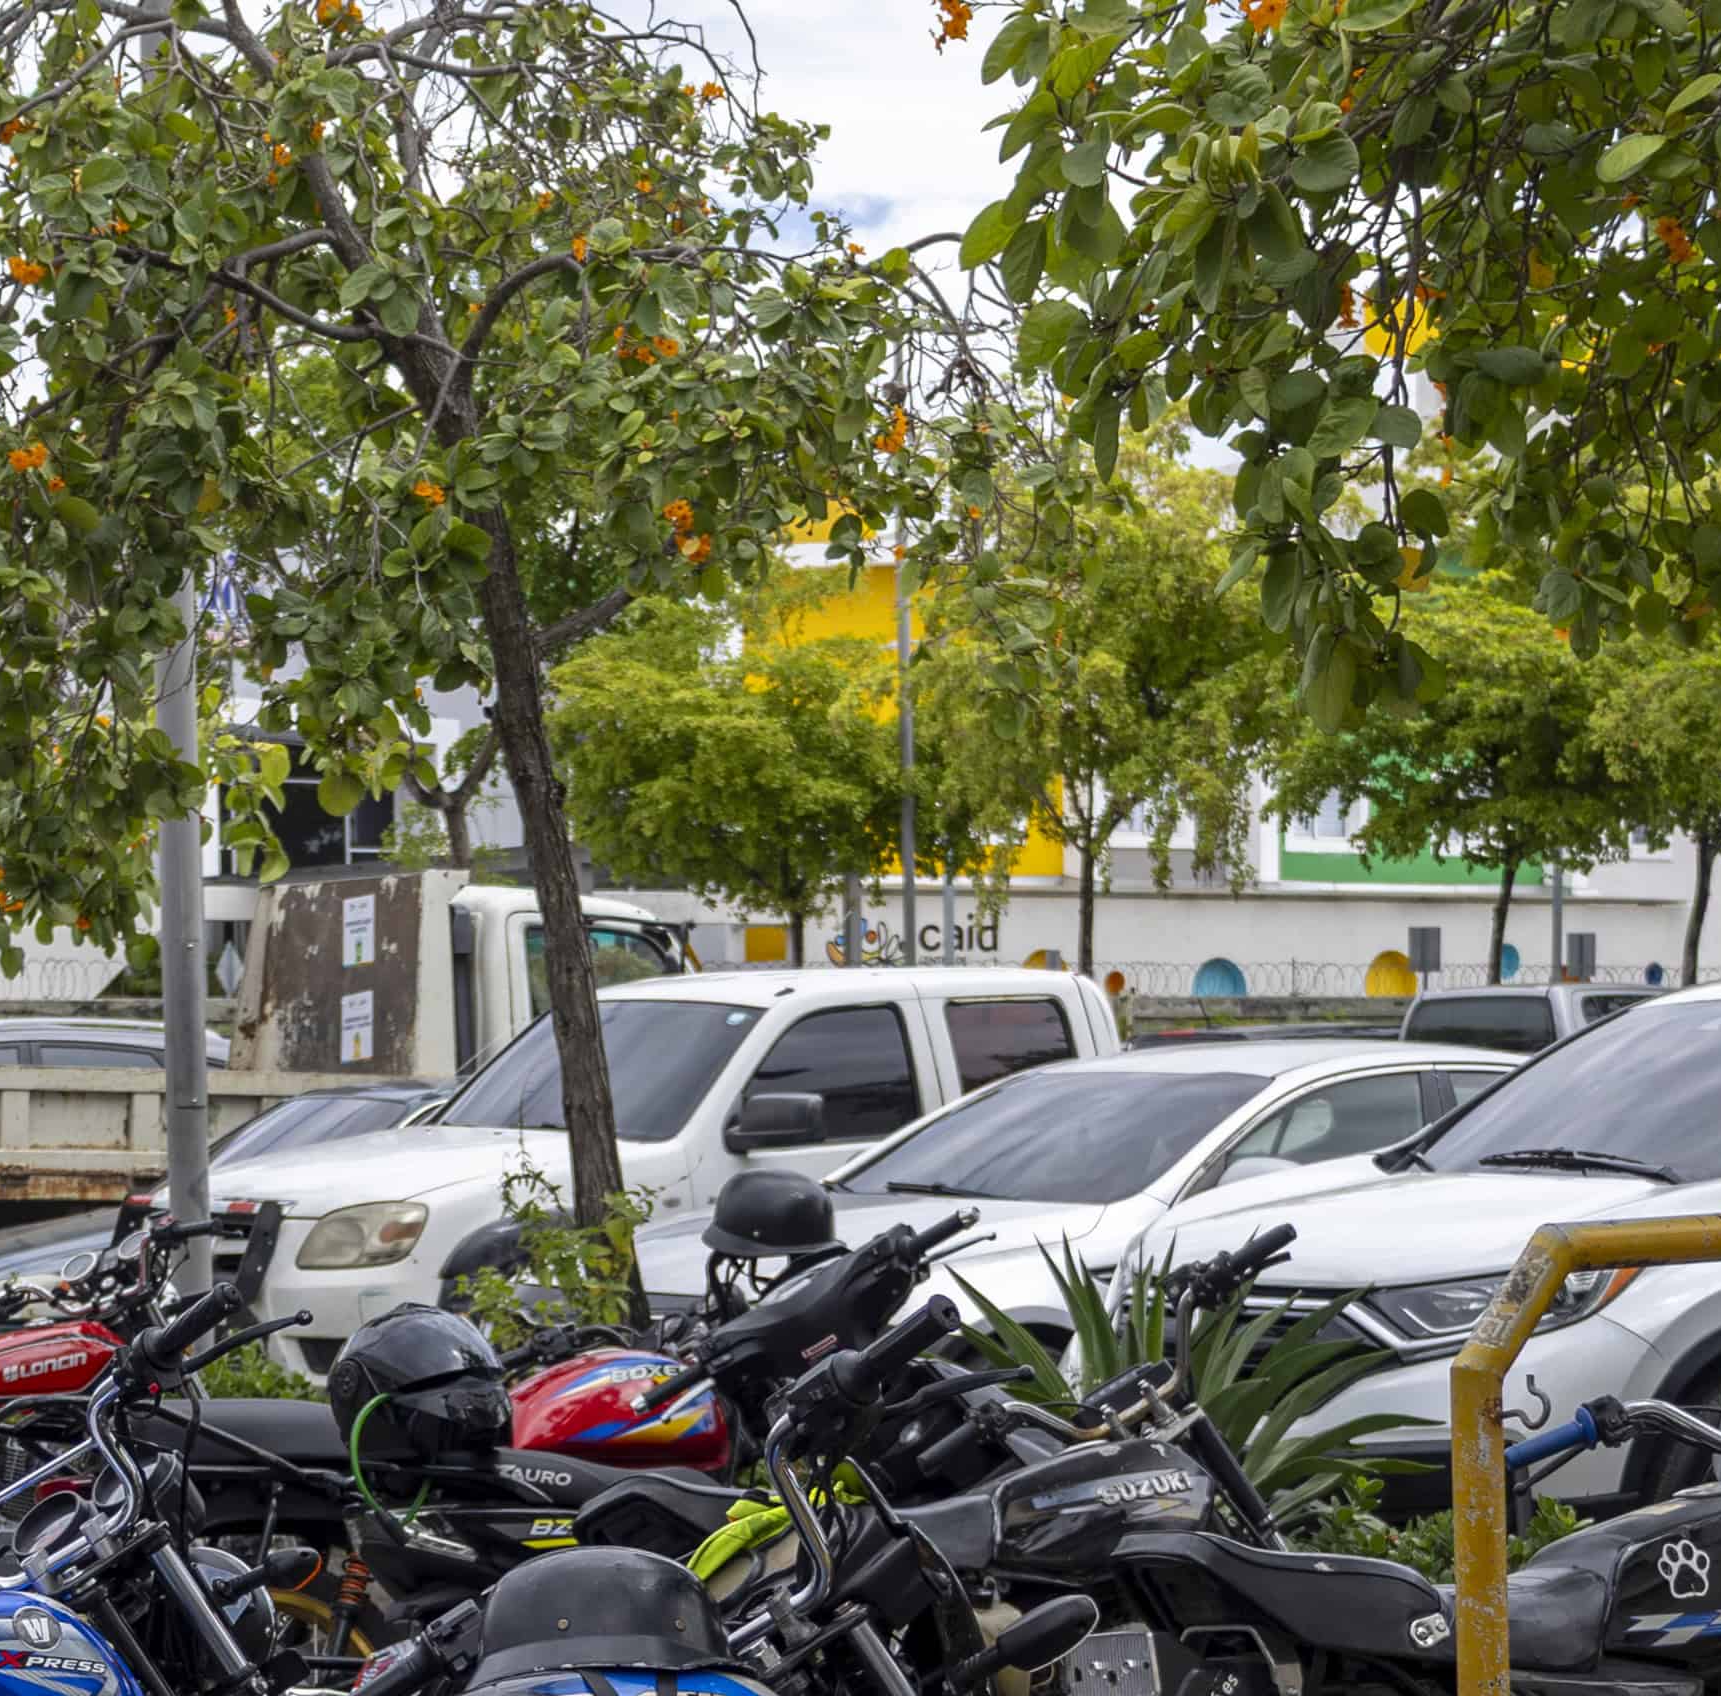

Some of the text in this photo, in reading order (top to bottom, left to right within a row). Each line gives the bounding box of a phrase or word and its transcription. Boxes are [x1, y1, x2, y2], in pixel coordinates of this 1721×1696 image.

[18, 1351, 88, 1377] LONCIN
[609, 1364, 685, 1384] BOXE
[1096, 1470, 1192, 1505] SUZUKI
[1221, 1673, 1239, 1695] es
